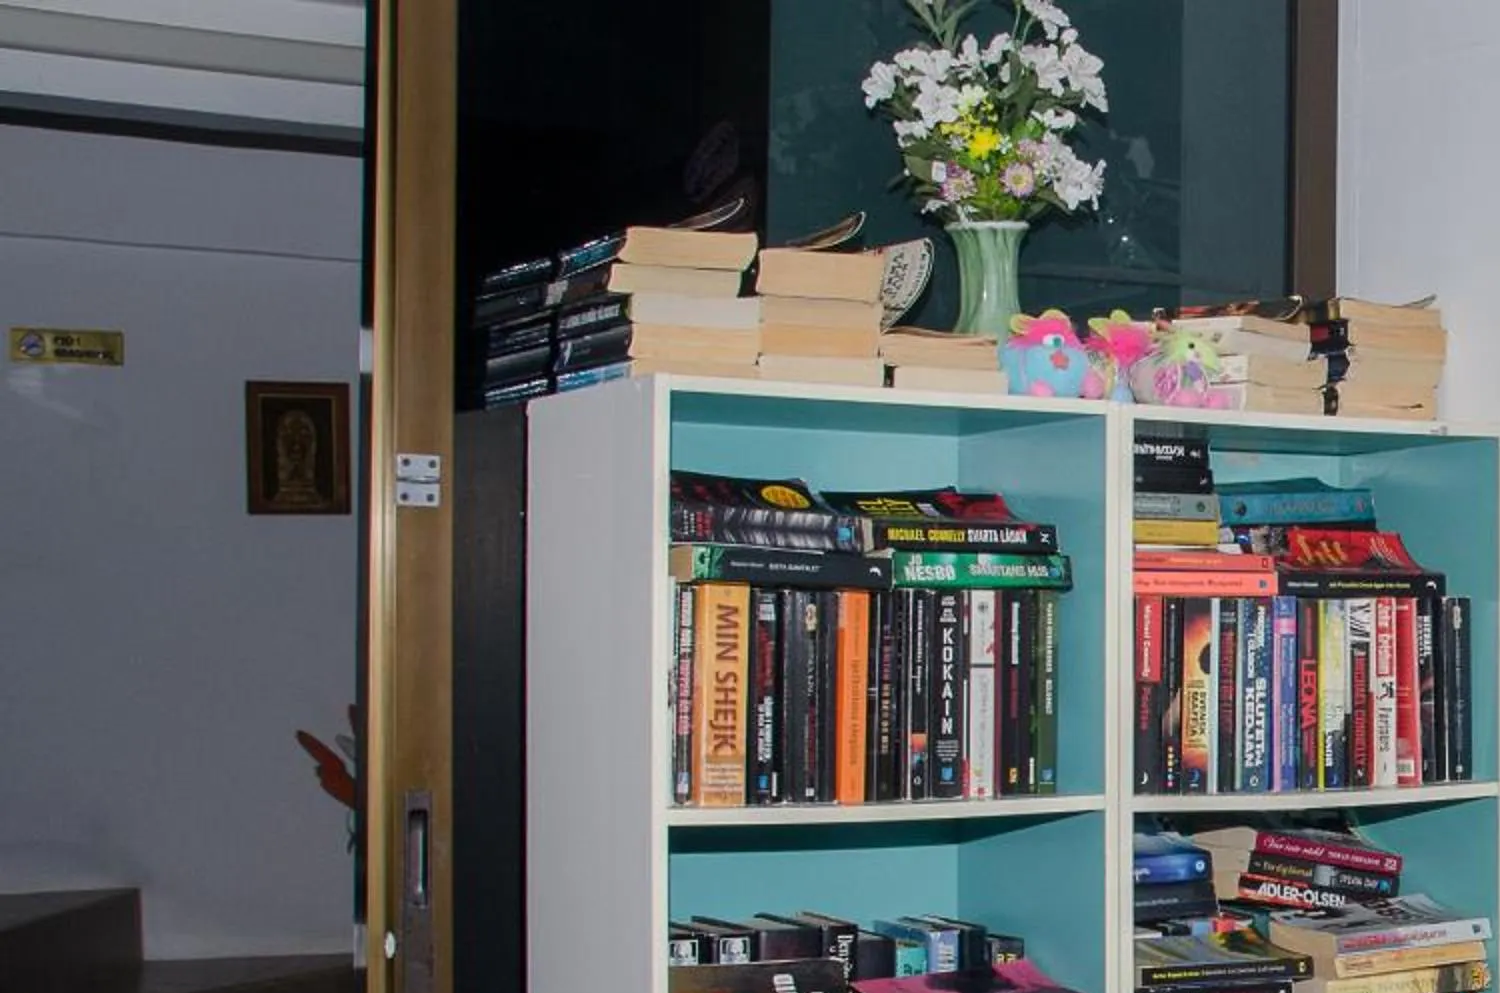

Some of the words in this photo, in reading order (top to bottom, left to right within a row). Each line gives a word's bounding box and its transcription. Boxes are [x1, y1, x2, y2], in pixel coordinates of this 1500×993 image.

[715, 604, 740, 661] MIN
[709, 671, 740, 755] SHEJK
[941, 627, 955, 735] KOKAIN
[1255, 677, 1267, 752] SLUTET
[1301, 659, 1317, 730] LEONA
[1244, 687, 1256, 768] KEDJAN
[1257, 882, 1347, 907] ADLER-OLSEN
